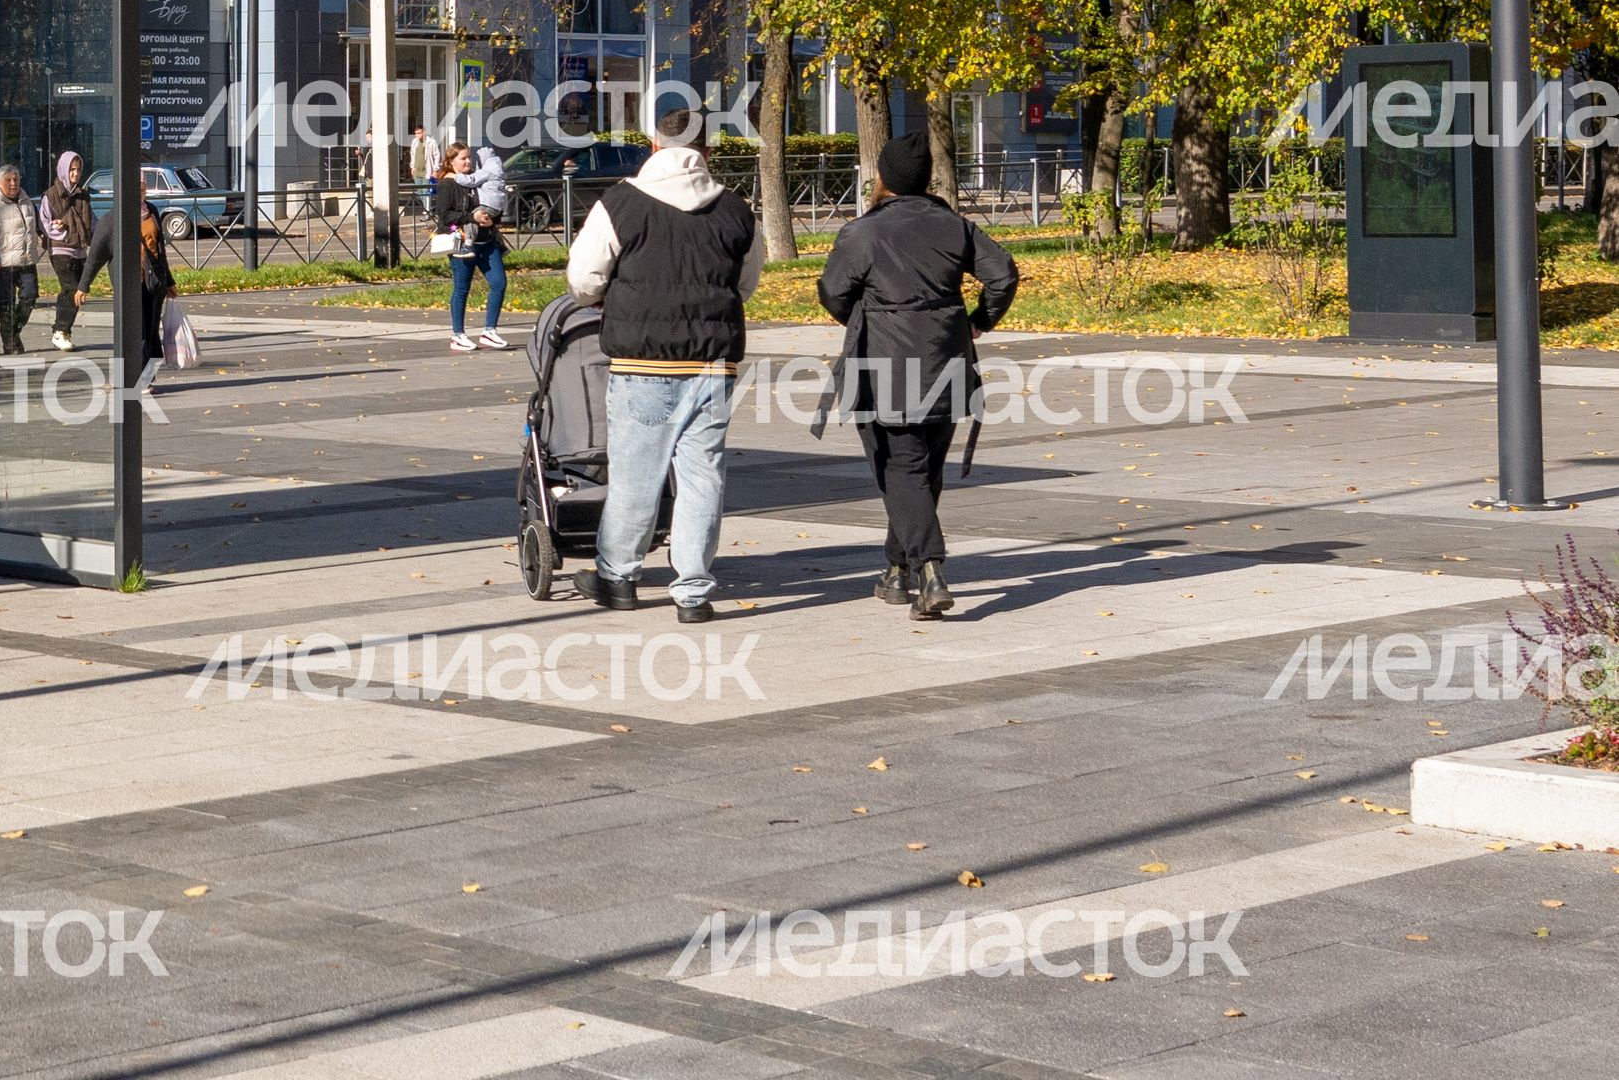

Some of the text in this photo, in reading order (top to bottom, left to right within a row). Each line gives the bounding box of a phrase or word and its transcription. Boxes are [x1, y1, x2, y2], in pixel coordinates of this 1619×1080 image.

[140, 34, 205, 44] ОРГОВЫЙ ЦЕНТР
[152, 56, 166, 65] :00
[174, 56, 201, 66] 23:00
[168, 77, 206, 85] ПАРКОВКА
[145, 97, 203, 105] УГЛОСУТОЧНО
